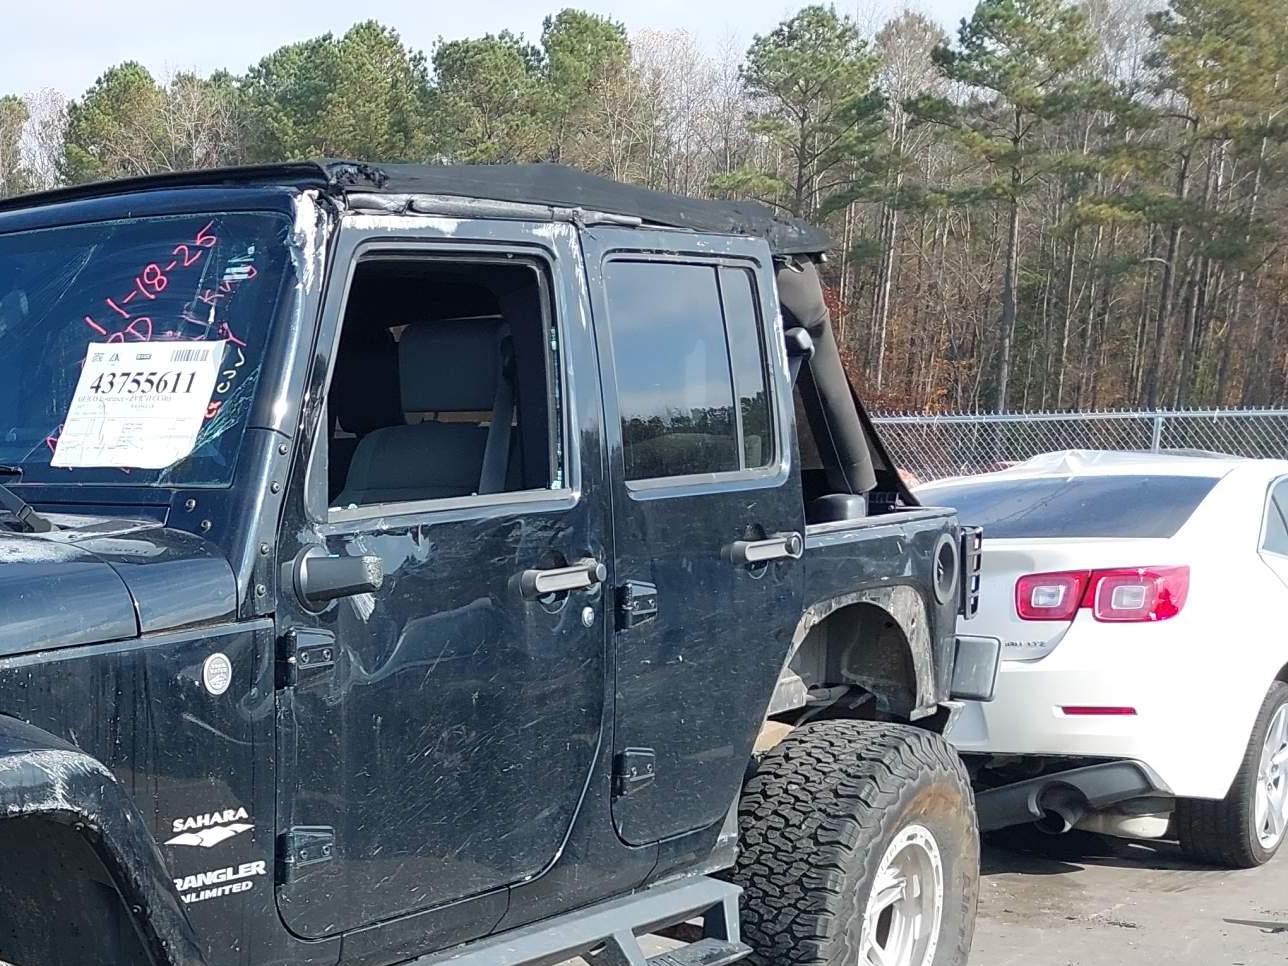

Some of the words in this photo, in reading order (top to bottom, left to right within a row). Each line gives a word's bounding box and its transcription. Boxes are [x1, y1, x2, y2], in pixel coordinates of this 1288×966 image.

[90, 371, 197, 394] 43755611
[172, 807, 249, 833] SAHARA
[173, 860, 268, 892] RANGLER
[180, 880, 254, 904] NLIMITED
